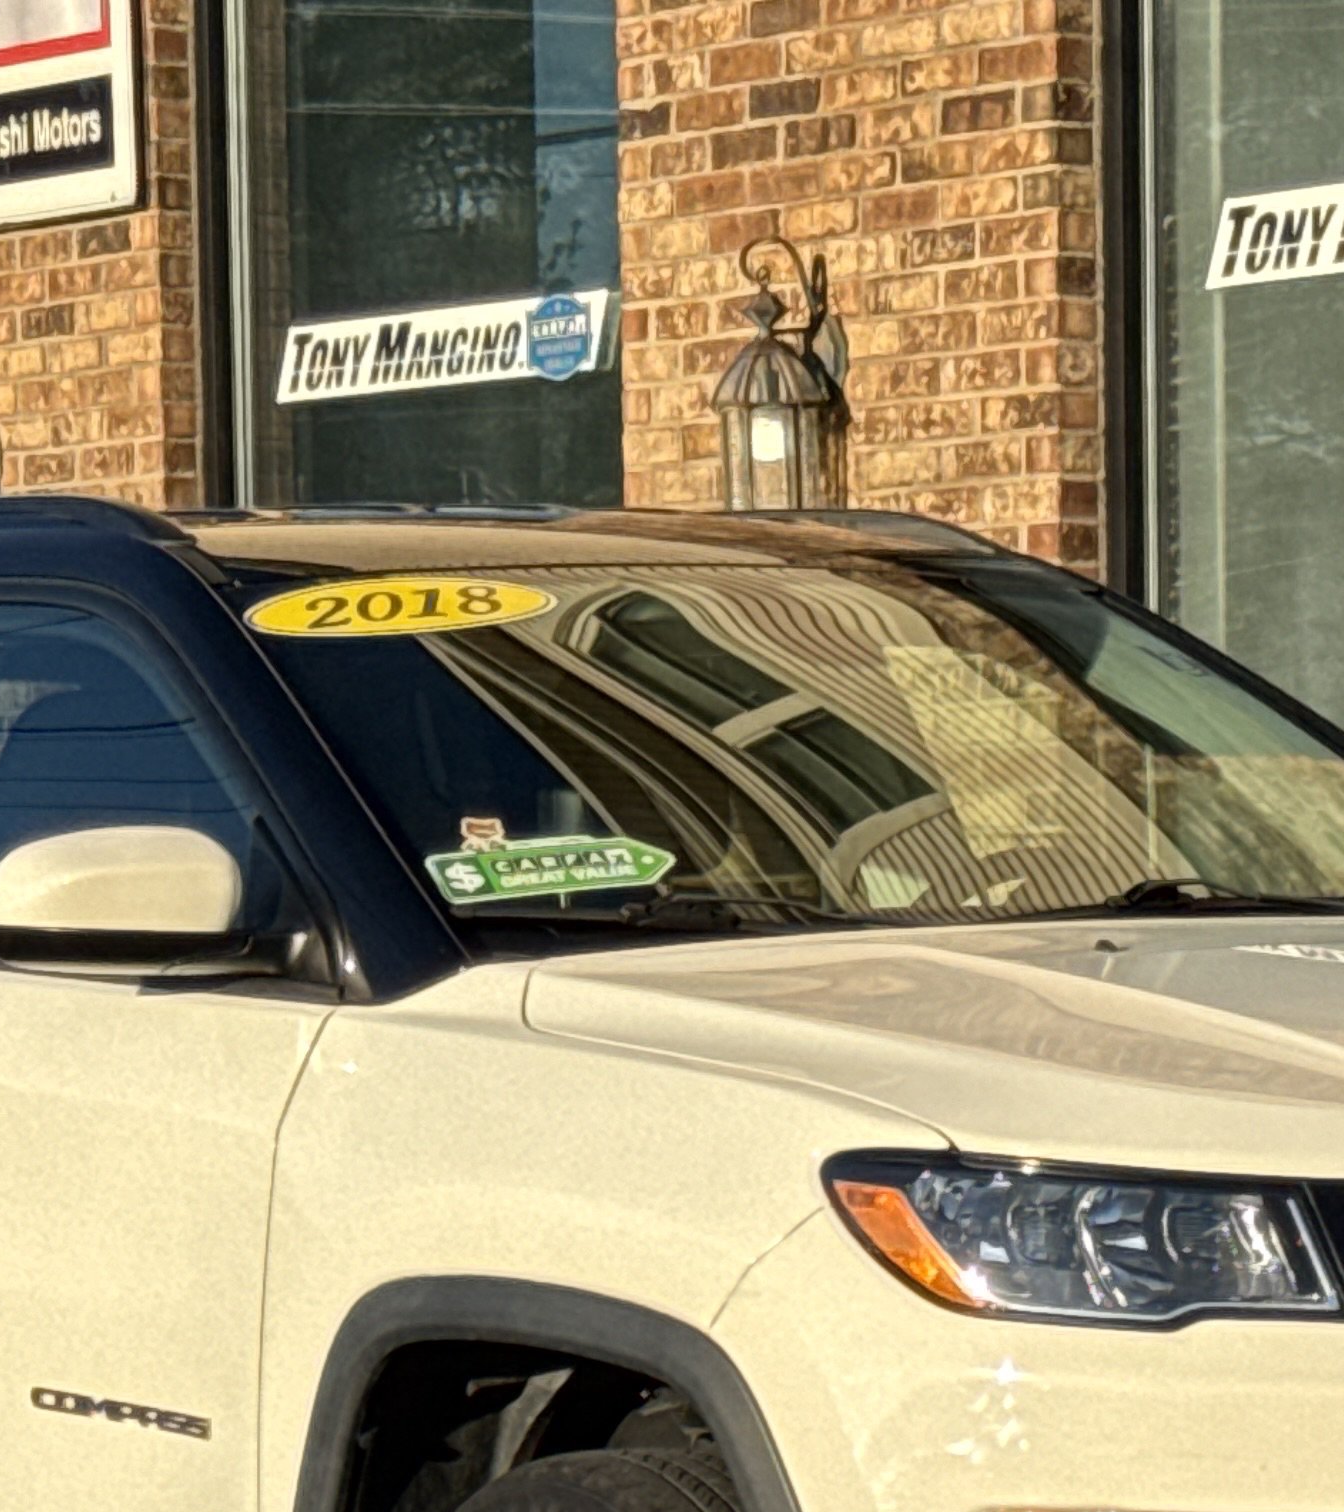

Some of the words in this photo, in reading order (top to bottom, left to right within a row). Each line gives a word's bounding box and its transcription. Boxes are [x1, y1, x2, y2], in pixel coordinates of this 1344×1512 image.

[33, 107, 102, 154] Motors
[1220, 204, 1337, 278] TONY
[288, 332, 371, 394] TONY
[304, 585, 503, 629] 2018
[491, 849, 634, 874] CARFAX
[500, 869, 566, 888] GREAT
[569, 864, 640, 881] VALUE
[30, 1386, 212, 1441] COMPASS
